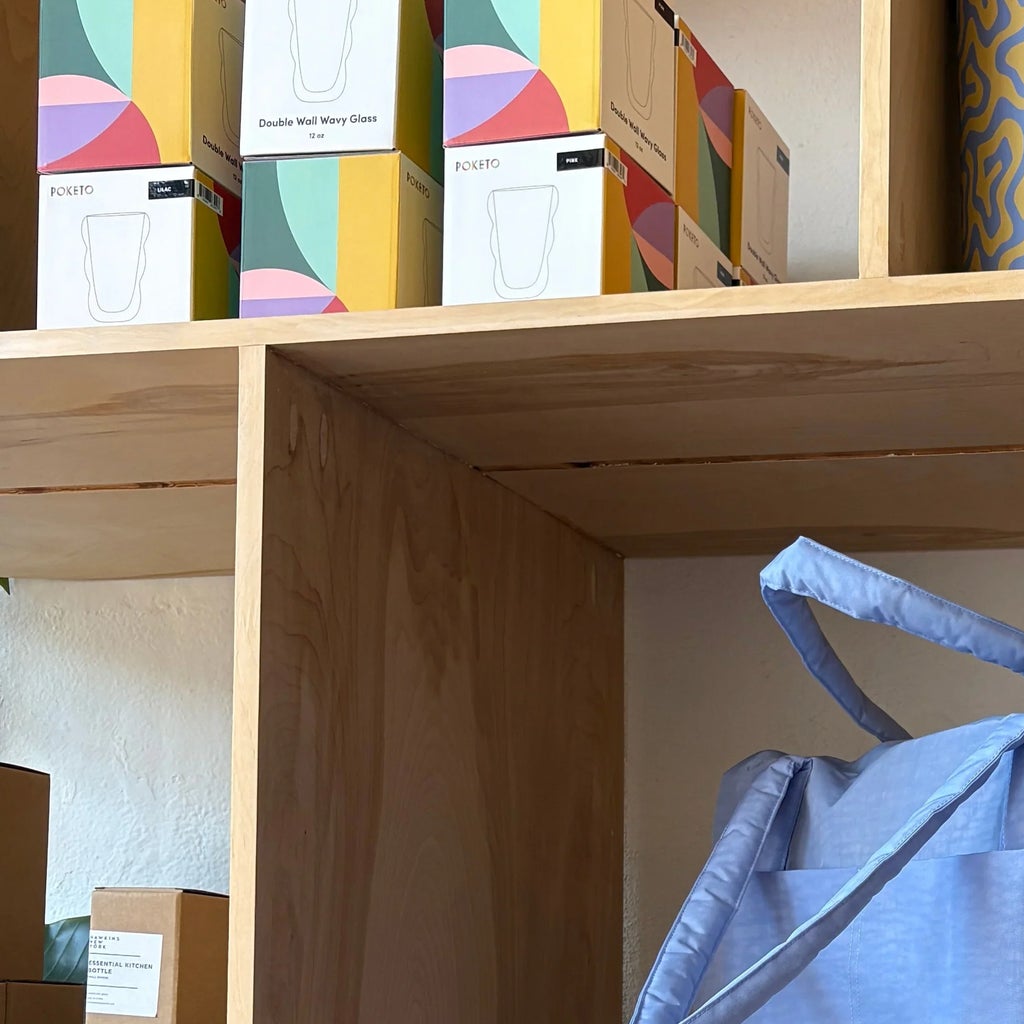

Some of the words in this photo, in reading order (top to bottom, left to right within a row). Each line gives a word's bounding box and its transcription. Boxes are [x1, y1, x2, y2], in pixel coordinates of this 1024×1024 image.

[259, 117, 294, 128] Double
[296, 116, 318, 126] Wall
[320, 115, 348, 126] Wavy
[350, 114, 378, 124] Glass
[456, 158, 500, 172] POKETO
[50, 185, 94, 197] POKETO
[406, 172, 430, 200] POKETO
[88, 960, 123, 968] ESSENTIAL
[124, 962, 153, 970] KITCHEN
